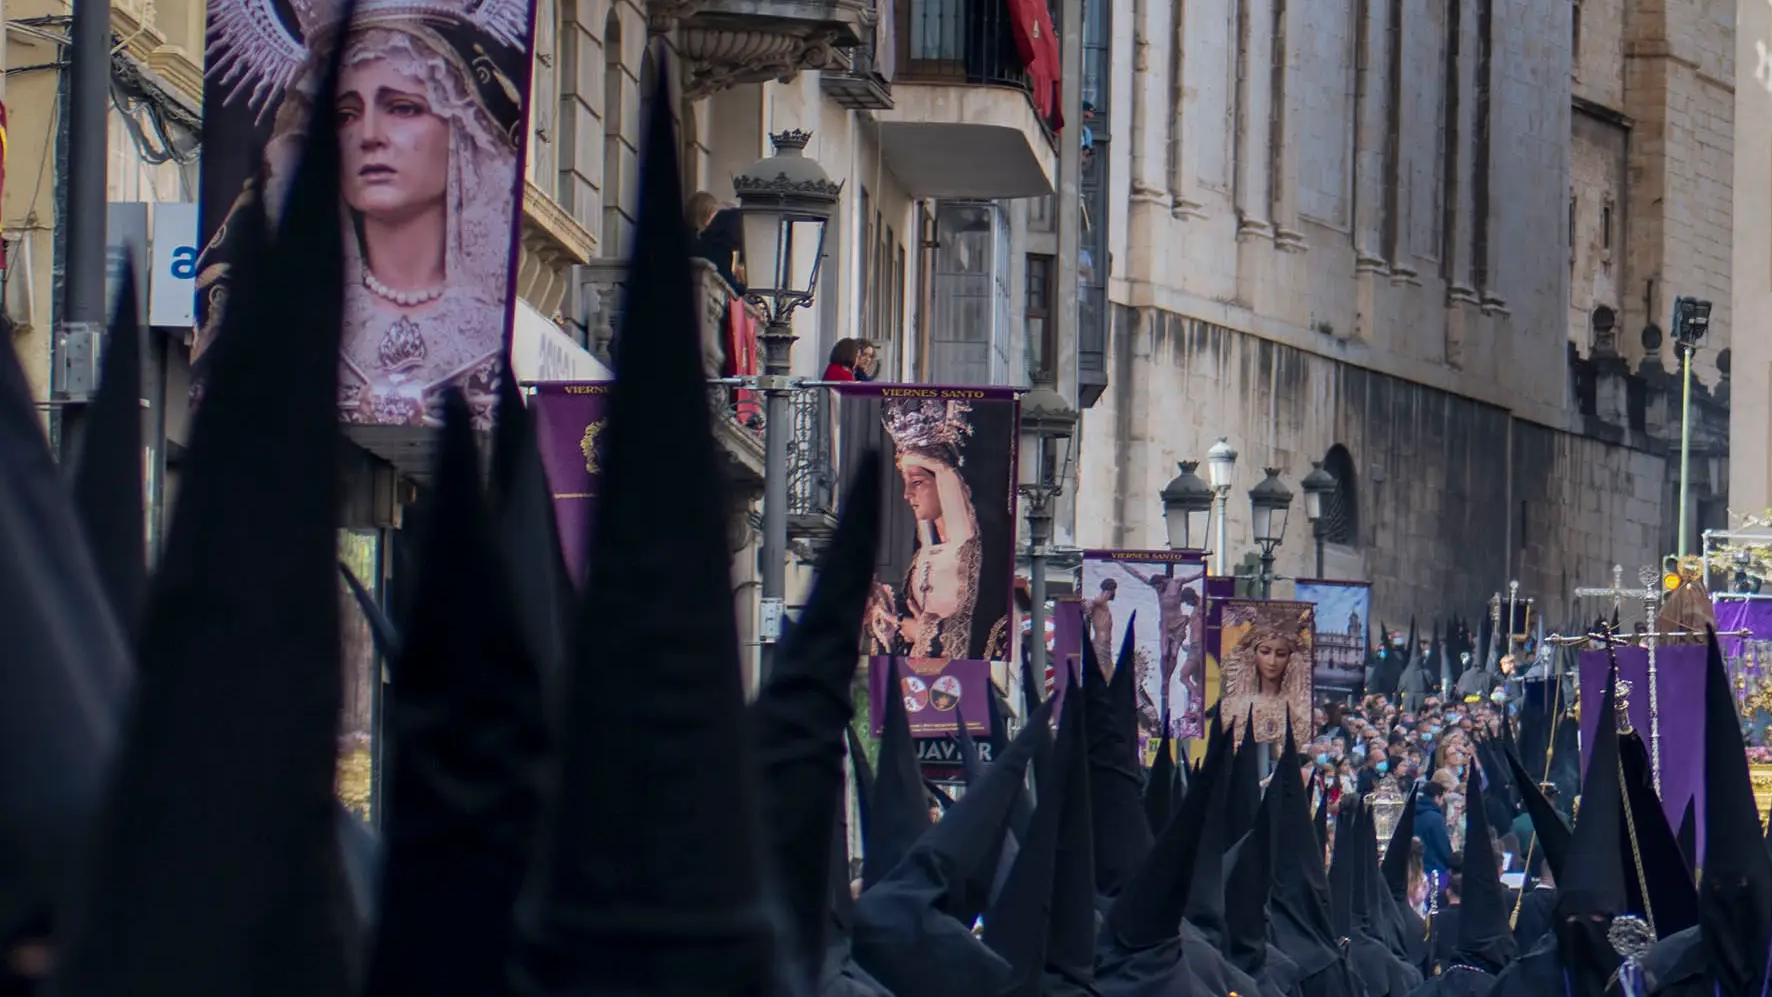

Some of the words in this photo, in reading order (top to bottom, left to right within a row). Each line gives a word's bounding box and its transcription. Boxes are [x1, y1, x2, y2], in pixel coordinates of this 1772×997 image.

[882, 387, 937, 398] VIERNES
[941, 389, 985, 399] SANTO
[1111, 552, 1149, 560] VIERNES
[1152, 553, 1182, 561] SANTO
